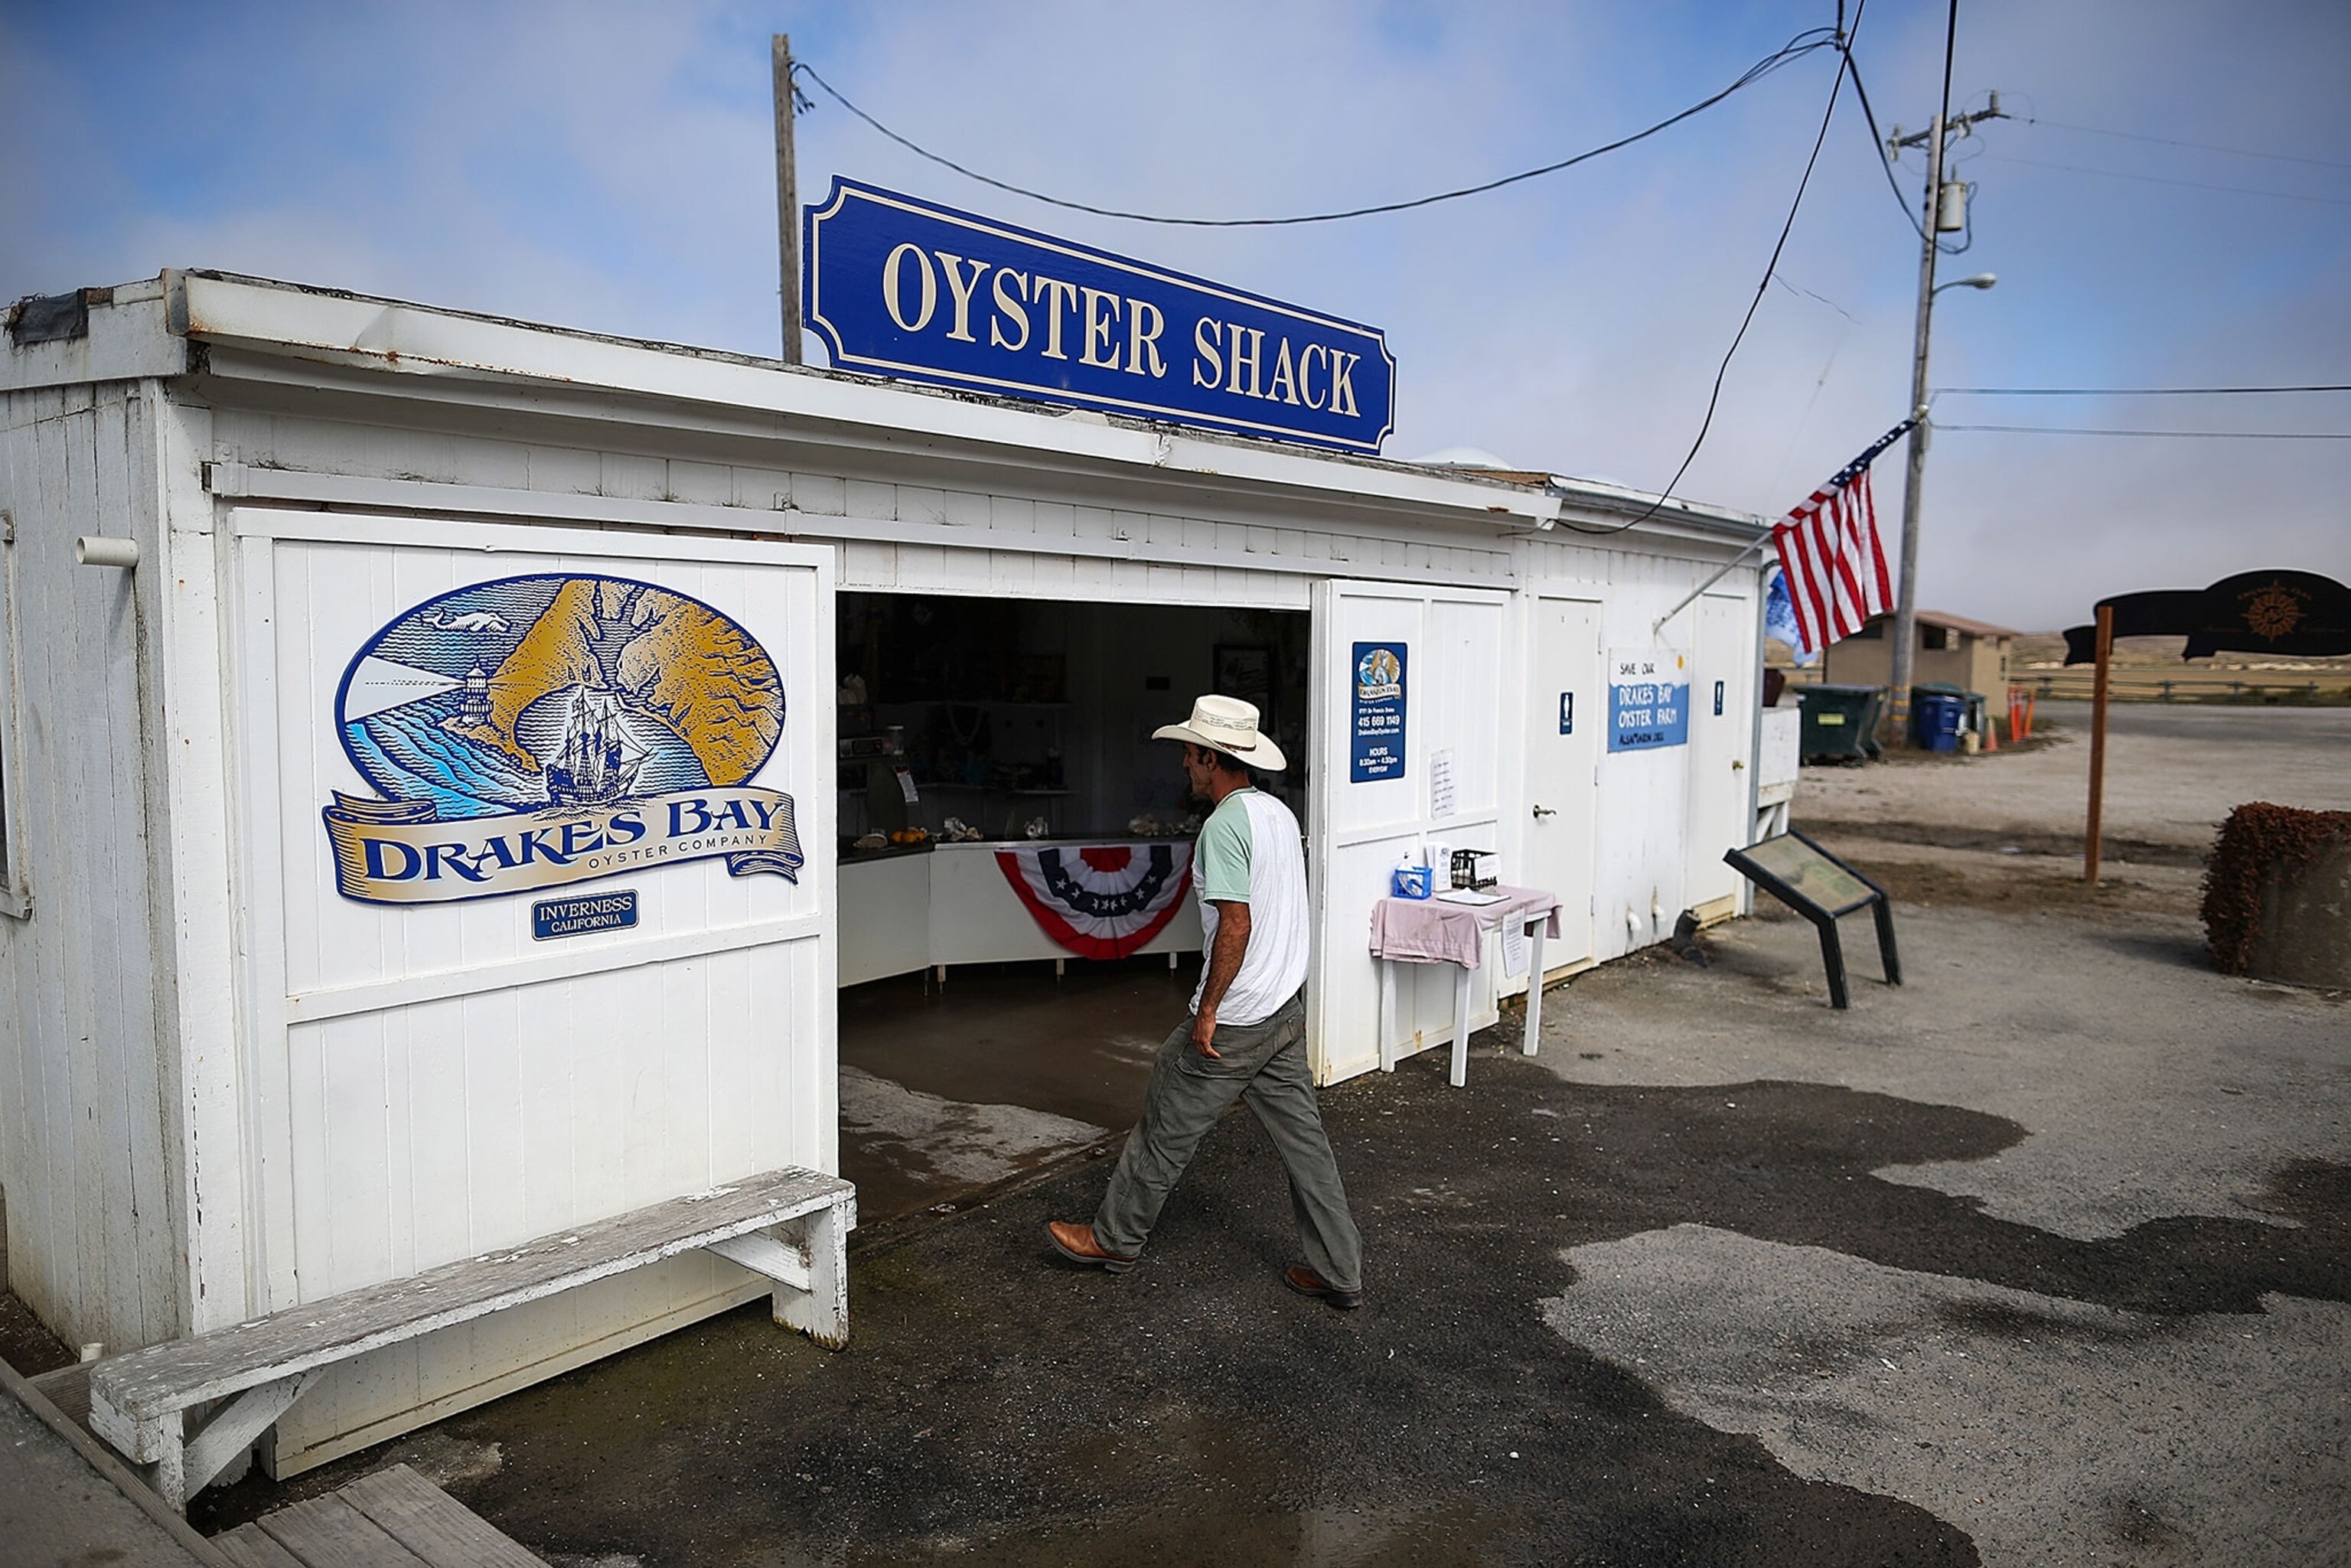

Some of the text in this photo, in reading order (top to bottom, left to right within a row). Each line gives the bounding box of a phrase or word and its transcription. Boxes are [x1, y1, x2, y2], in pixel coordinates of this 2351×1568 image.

[882, 243, 1361, 418] OYSTER SHACK
[1620, 663, 1655, 675] SAVE OUR
[1619, 685, 1674, 706] DRAKES BAY
[1358, 715, 1400, 727] 415 669 1149
[1619, 707, 1678, 728] OYSTER FARM
[1369, 747, 1388, 757] HOURS
[359, 798, 783, 882] DRAKES BAY
[589, 834, 767, 869] OYSTER COMPANY
[540, 895, 633, 921] INVERNESS
[551, 914, 622, 933] CALIFORNIA
